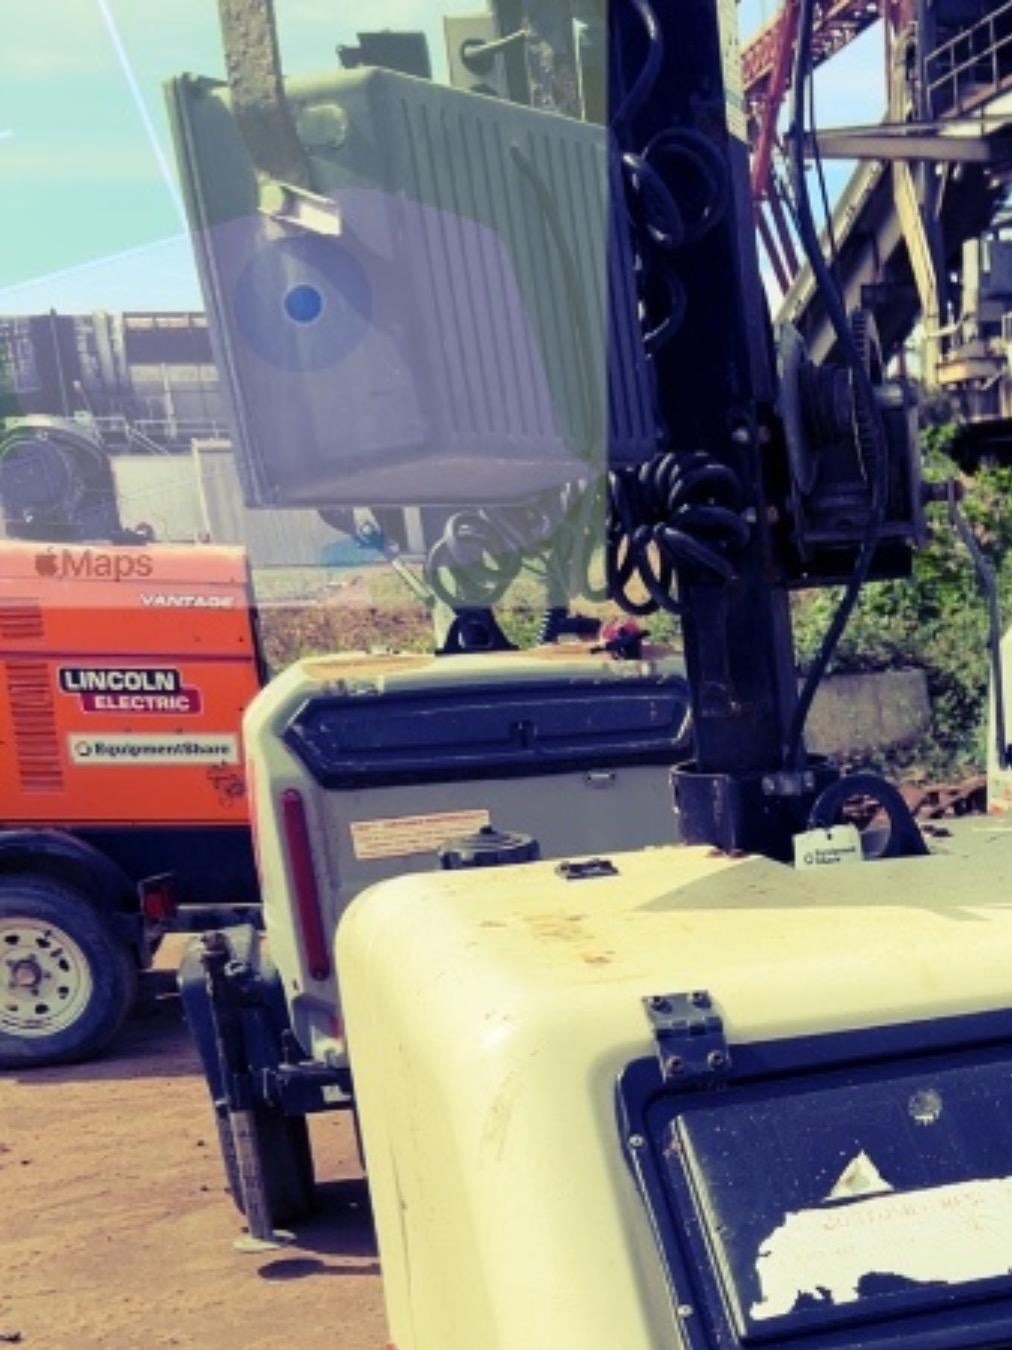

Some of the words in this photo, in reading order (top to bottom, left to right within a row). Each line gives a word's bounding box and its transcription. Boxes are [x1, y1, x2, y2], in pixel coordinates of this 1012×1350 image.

[140, 593, 235, 608] VANTAGE
[64, 671, 175, 692] LINCOLN
[94, 695, 190, 711] ELECTRIC
[94, 742, 231, 758] EquipmentShare
